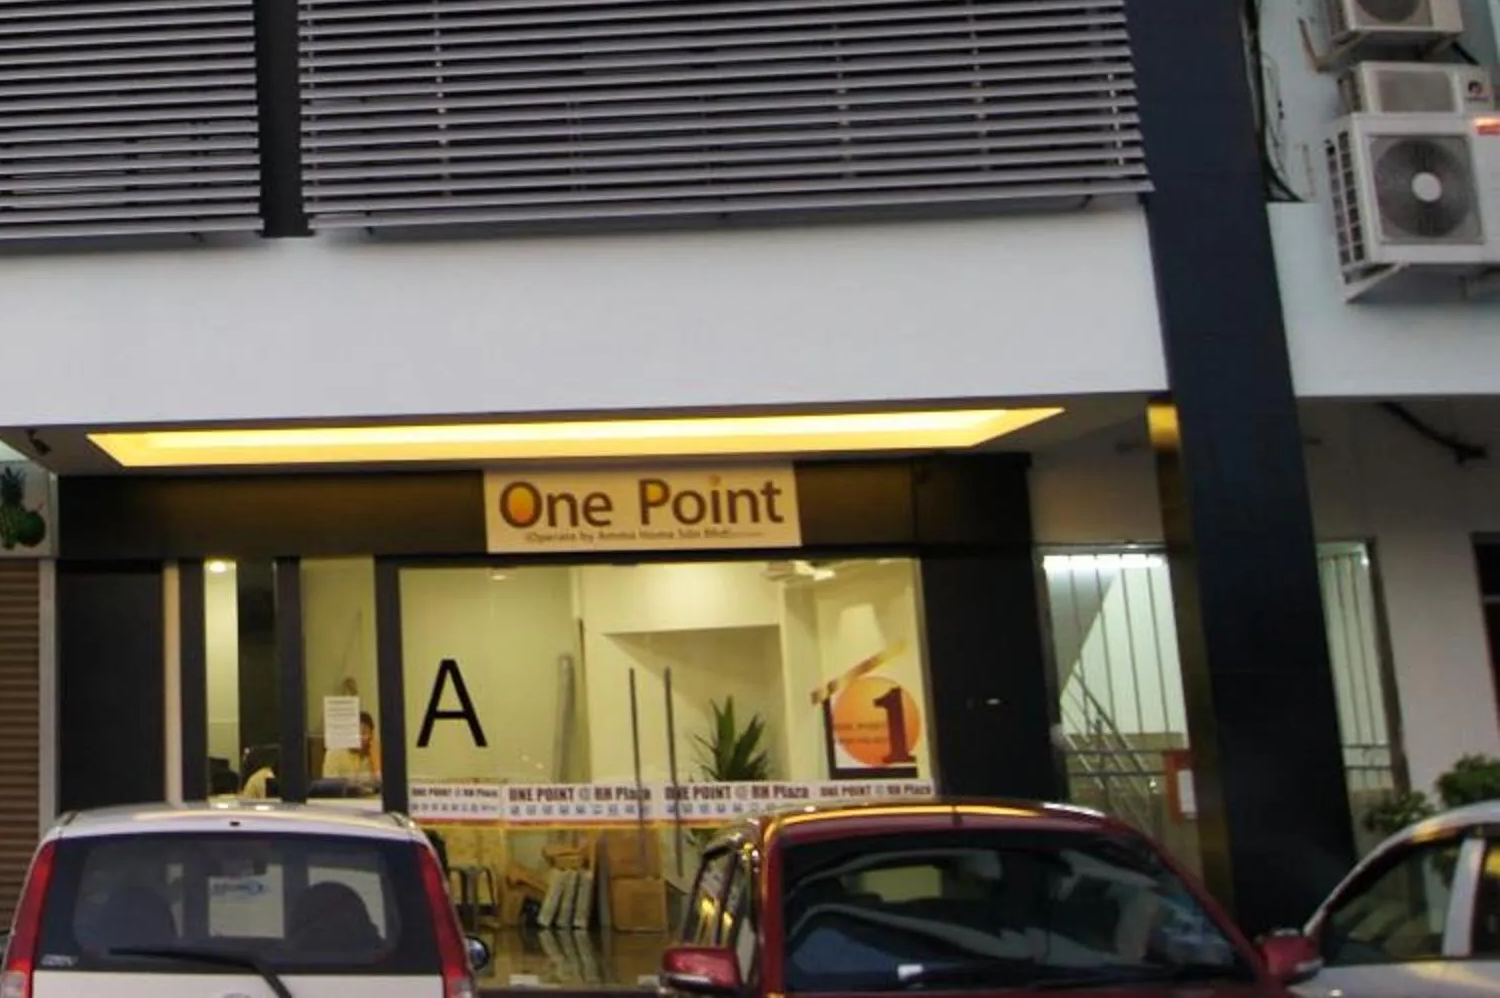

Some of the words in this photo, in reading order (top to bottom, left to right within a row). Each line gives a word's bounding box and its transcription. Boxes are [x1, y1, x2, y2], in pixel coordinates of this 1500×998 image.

[499, 479, 614, 529] One
[638, 473, 785, 527] Point
[416, 658, 488, 748] A
[872, 685, 917, 763] 1
[509, 786, 532, 802] ONE
[536, 786, 574, 802] POINT
[665, 785, 689, 800] ONE
[693, 785, 731, 800] POINT
[773, 784, 809, 799] Plaza
